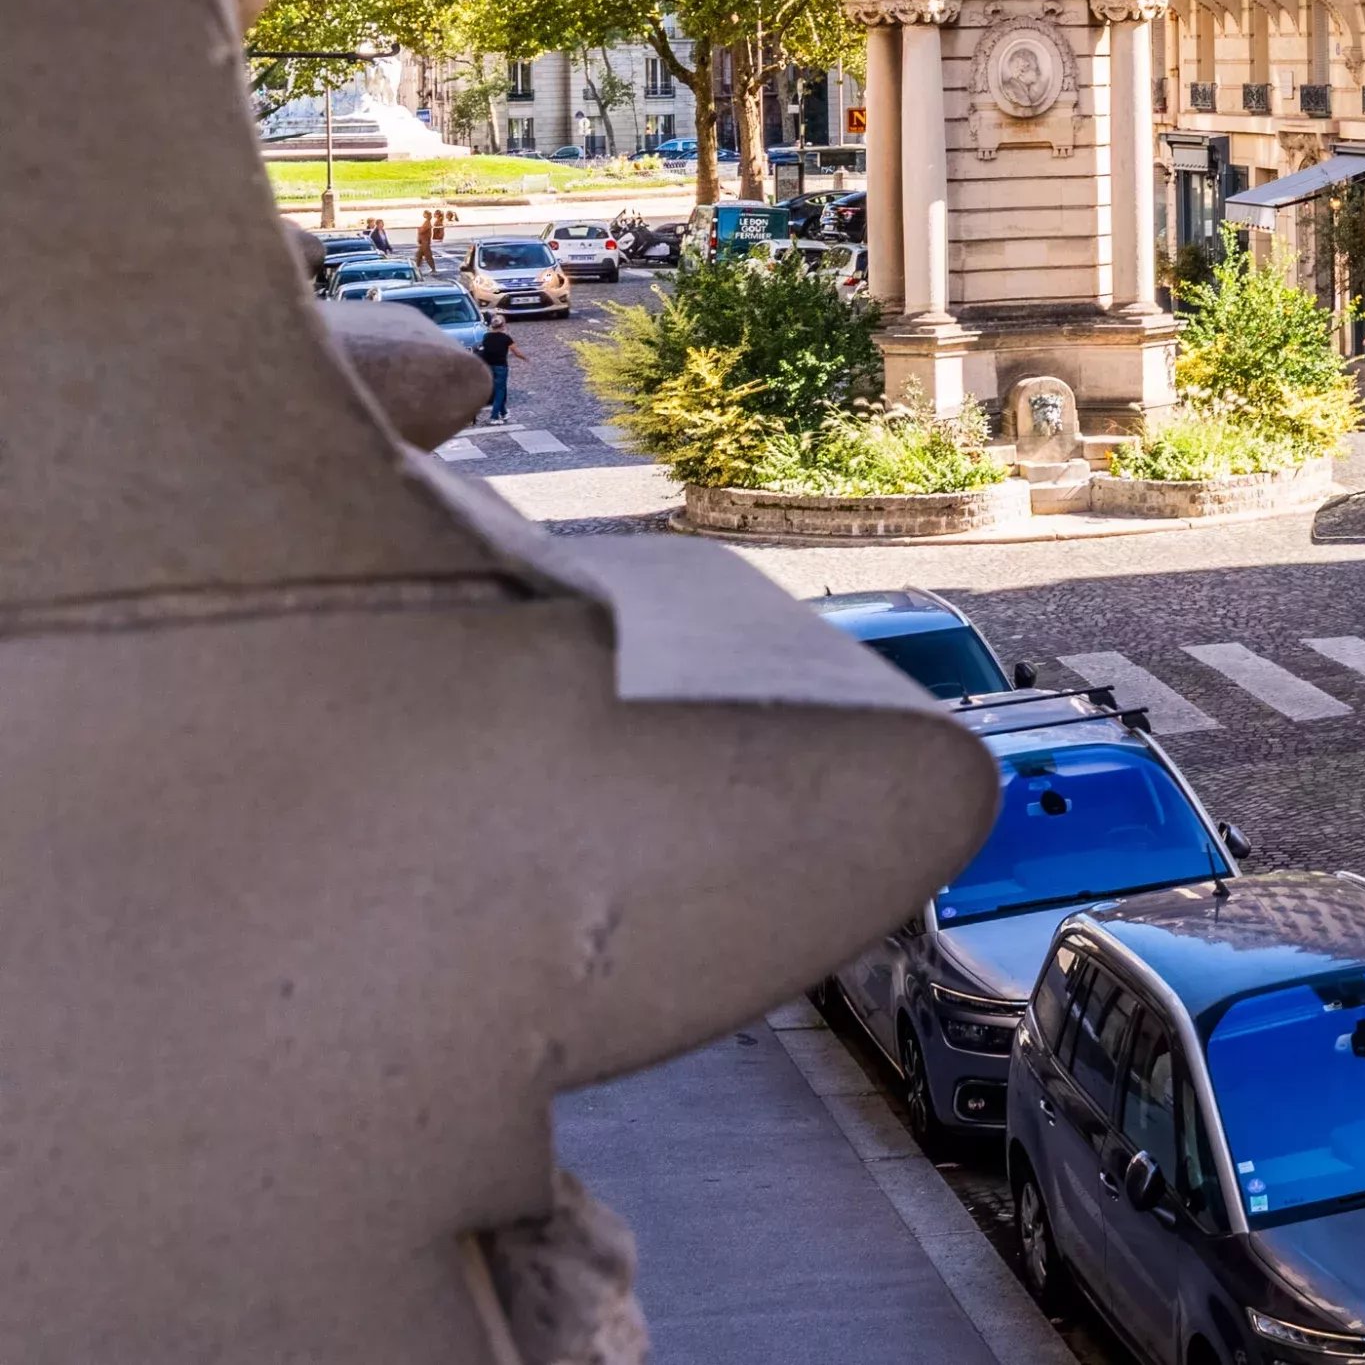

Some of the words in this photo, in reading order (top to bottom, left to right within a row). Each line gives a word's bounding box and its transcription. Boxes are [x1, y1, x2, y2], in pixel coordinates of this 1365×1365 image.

[739, 218, 749, 226] LE
[749, 218, 769, 226] BON
[735, 232, 772, 240] FERMIER
